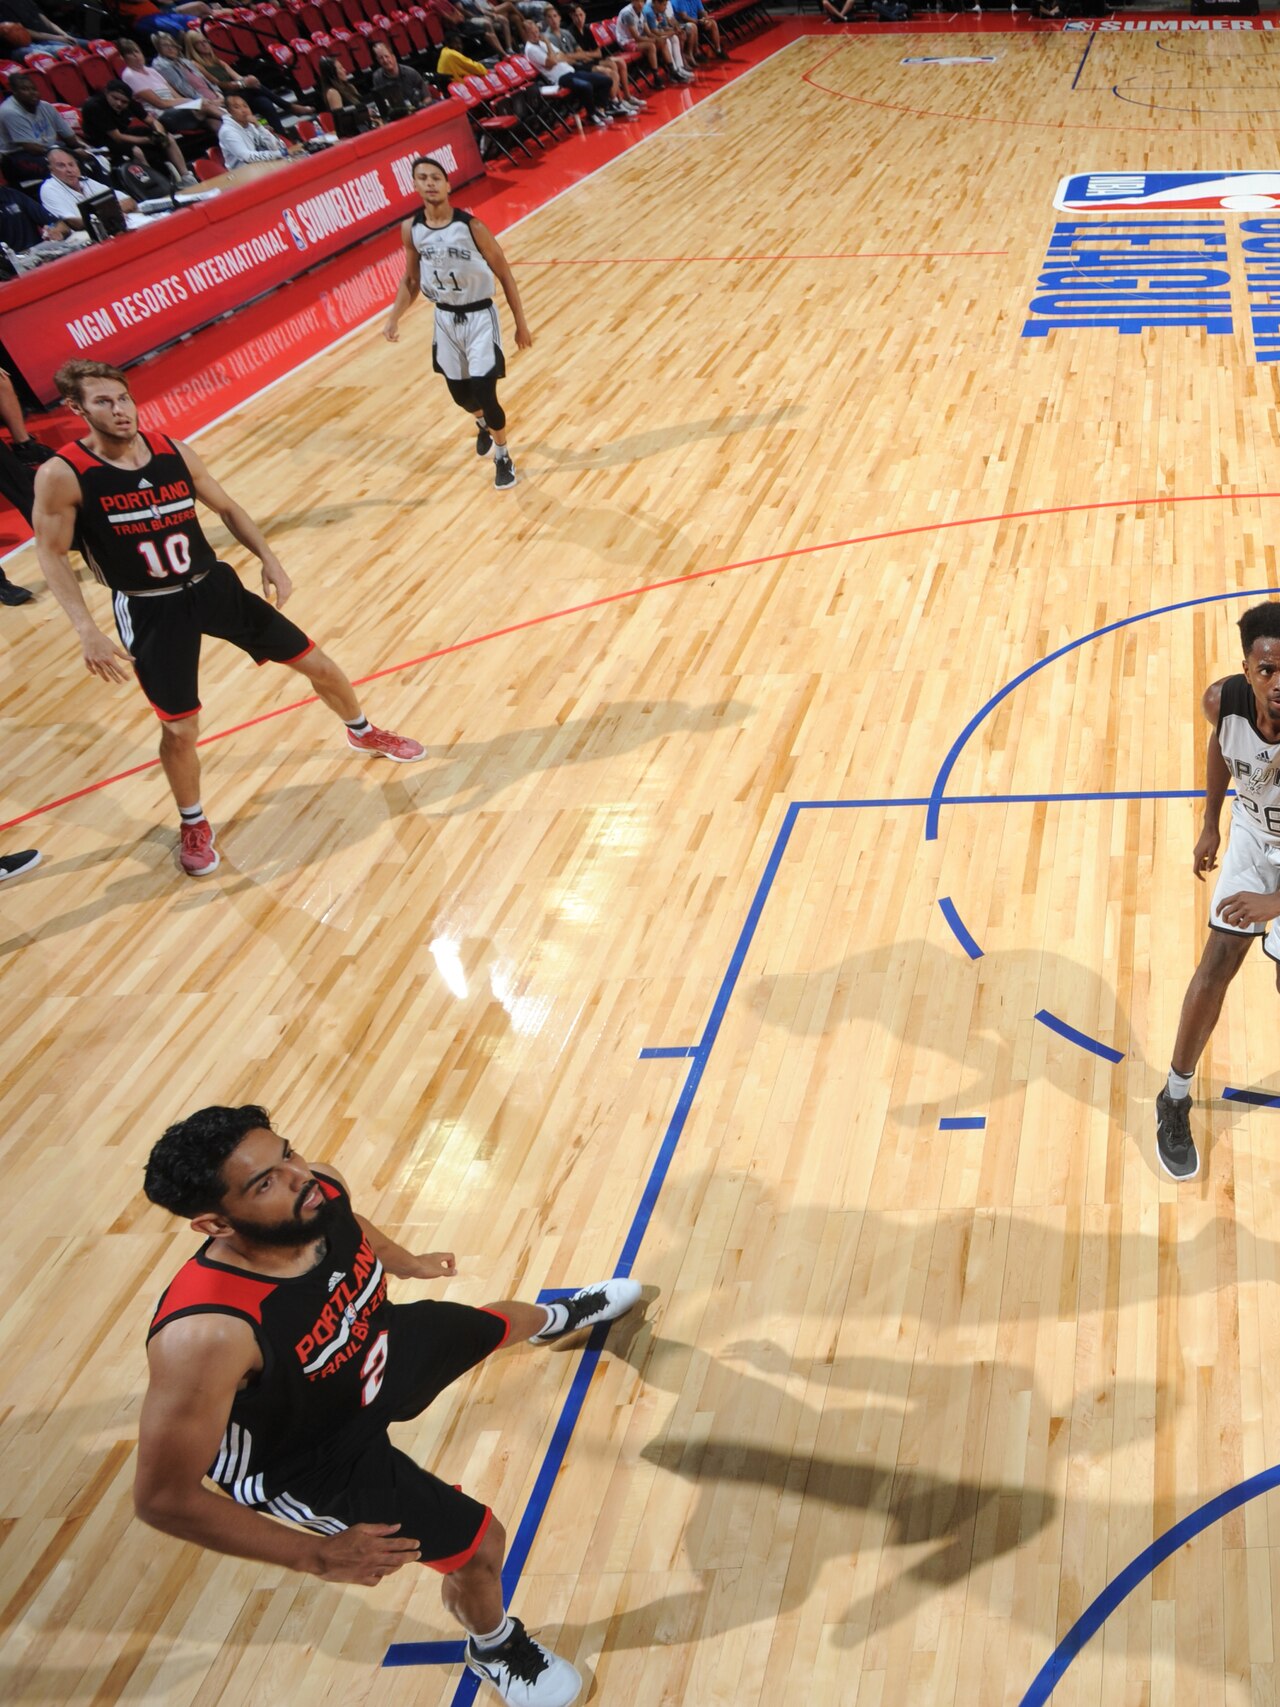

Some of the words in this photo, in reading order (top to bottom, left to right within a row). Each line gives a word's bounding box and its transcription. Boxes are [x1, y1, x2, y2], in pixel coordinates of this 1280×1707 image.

[1098, 20, 1255, 31] SUMMER
[1085, 176, 1146, 197] NBA
[66, 308, 118, 349] MGM
[111, 275, 189, 329] RESORTS
[295, 184, 356, 244] SUMMER
[342, 169, 391, 220] LEAGUE
[433, 270, 462, 292] 11
[1021, 220, 1234, 337] LEAGUE
[100, 480, 190, 513] PORTLAND
[113, 521, 151, 536] TRAIL
[151, 509, 196, 532] BLAZERS
[137, 532, 192, 579] 10
[306, 1340, 362, 1382] TRAIL
[359, 1329, 389, 1408] 2
